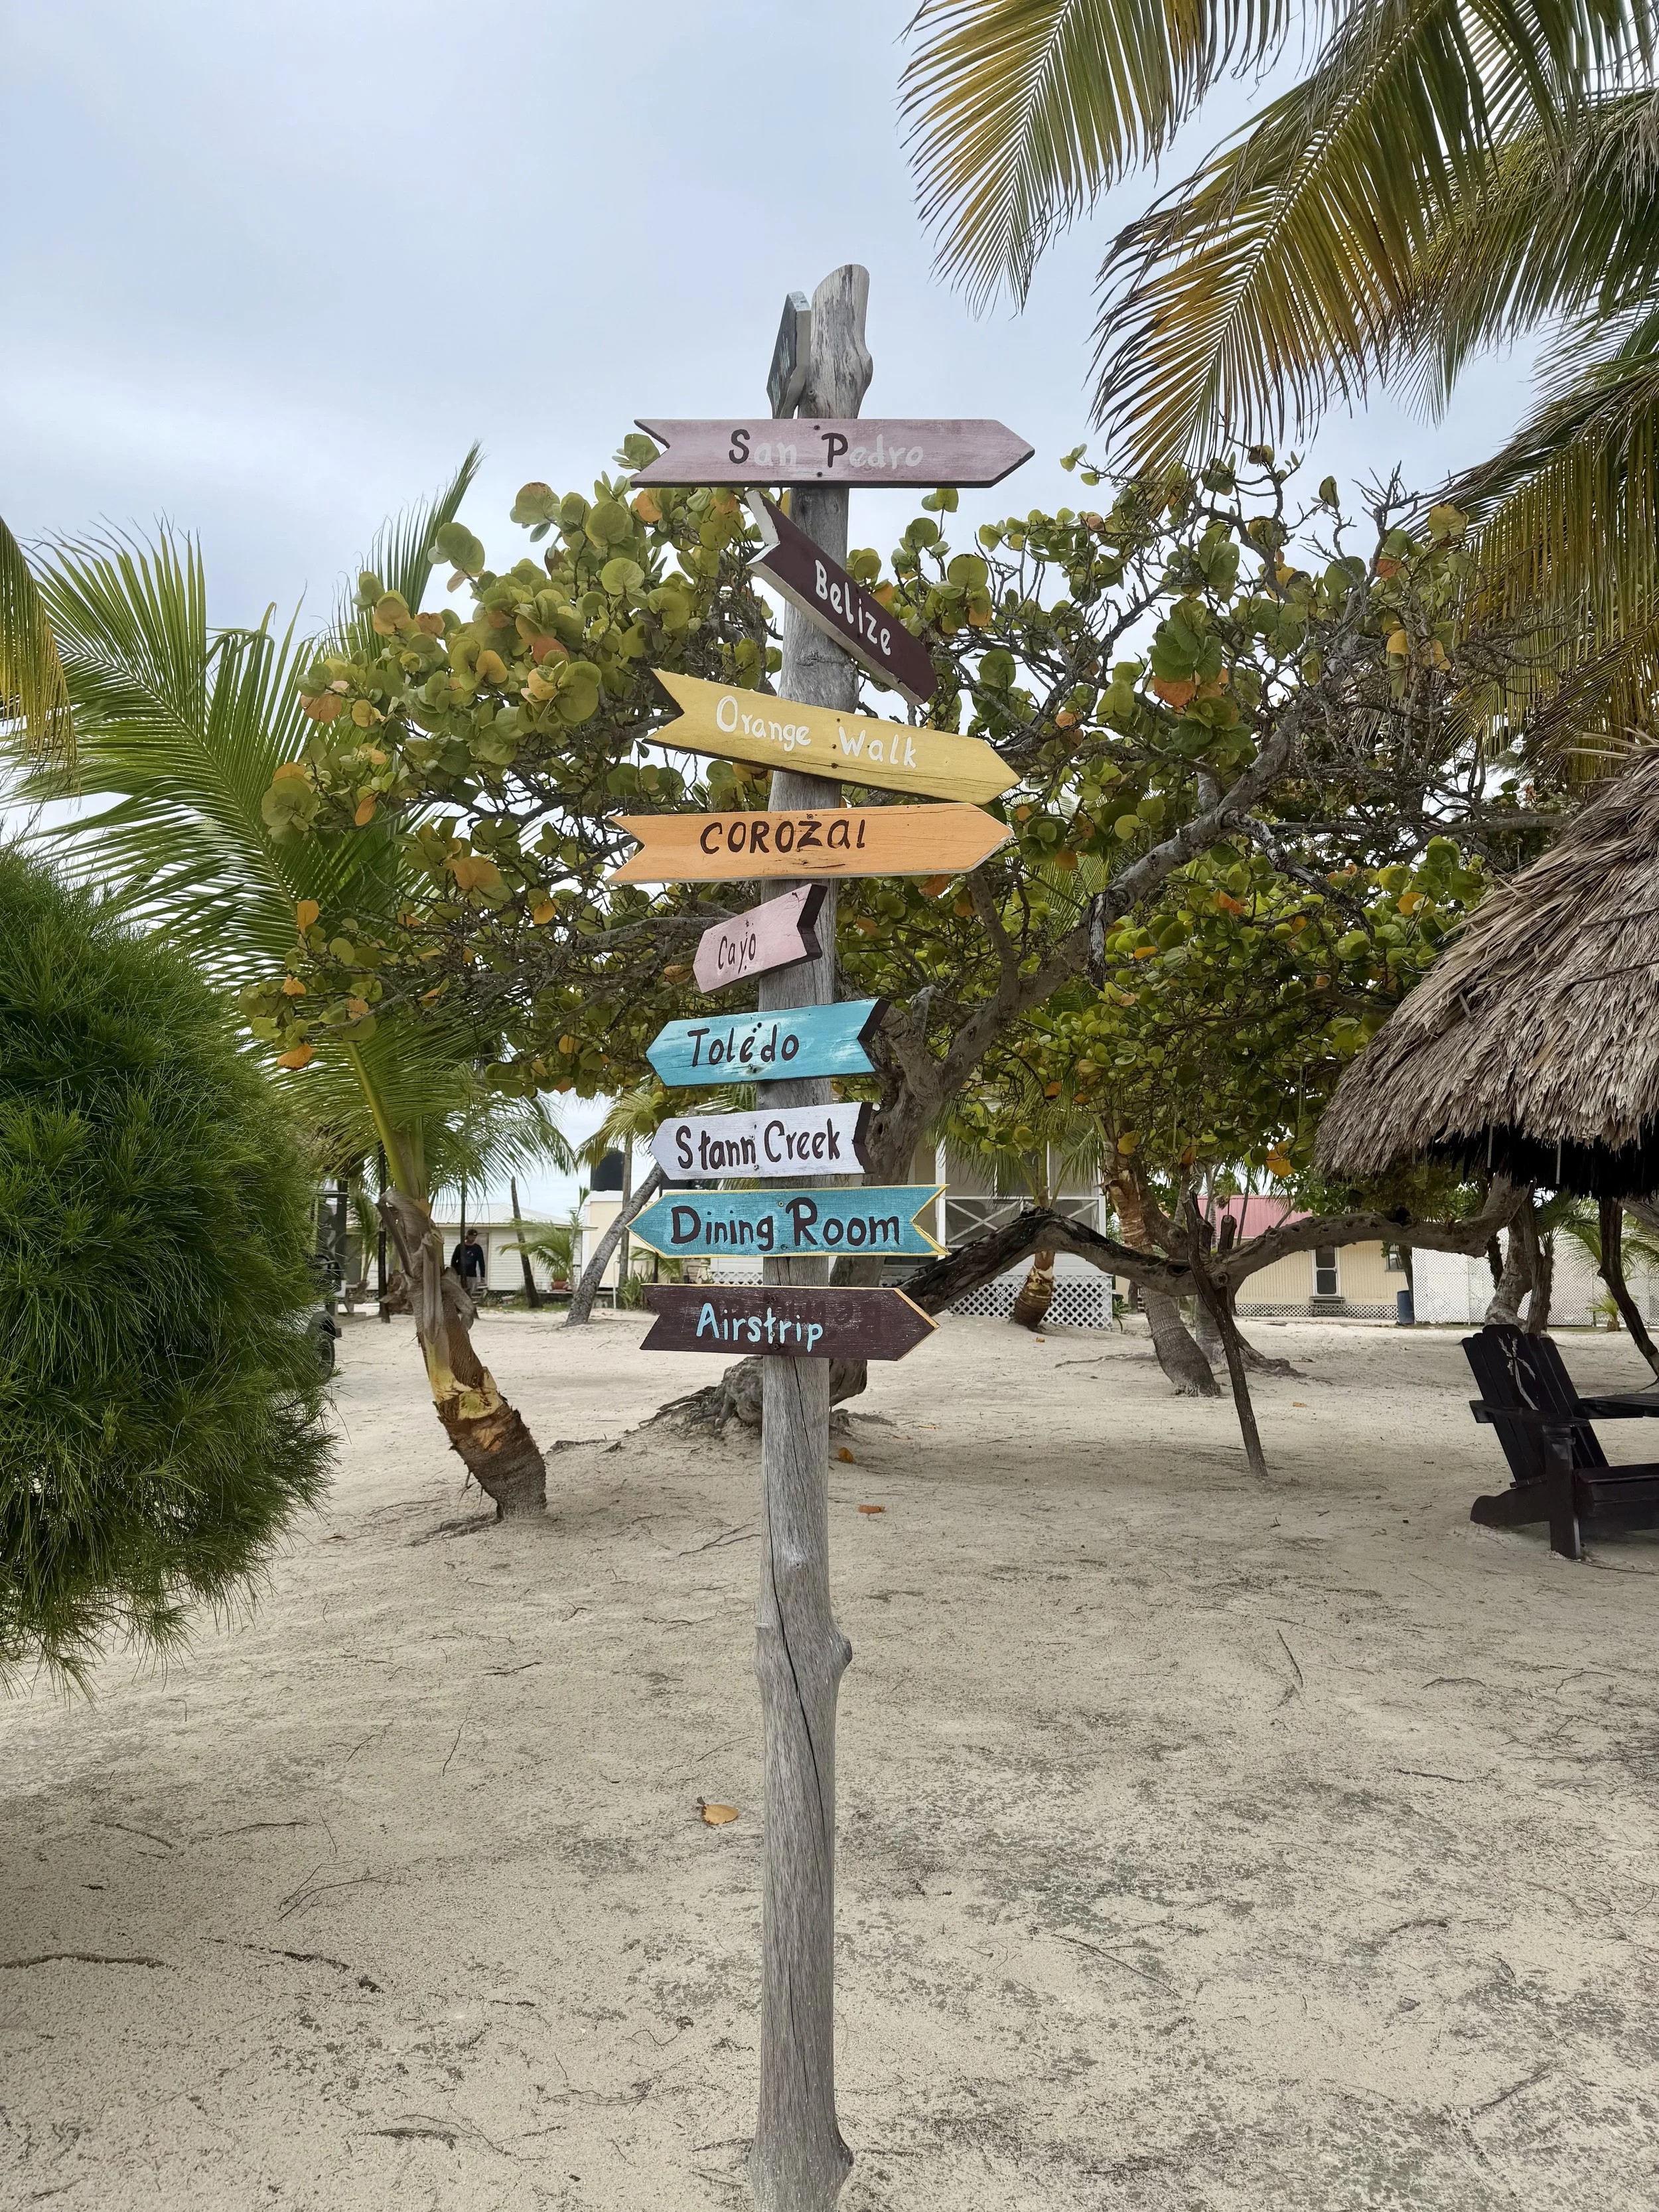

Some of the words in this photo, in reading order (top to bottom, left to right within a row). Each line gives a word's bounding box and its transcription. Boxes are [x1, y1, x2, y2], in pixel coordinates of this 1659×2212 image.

[729, 429, 796, 467] San
[822, 433, 924, 469] Pedro
[814, 559, 891, 656] Belize
[716, 696, 811, 751] Orange
[838, 725, 916, 769] Walk
[718, 933, 756, 974] Cayo
[687, 1025, 800, 1067] Toledo
[676, 1125, 757, 1170] Stann
[764, 1118, 840, 1162] Creek
[671, 1205, 774, 1250] Dining
[785, 1197, 900, 1246] Room
[695, 1303, 824, 1352] Airstrip
